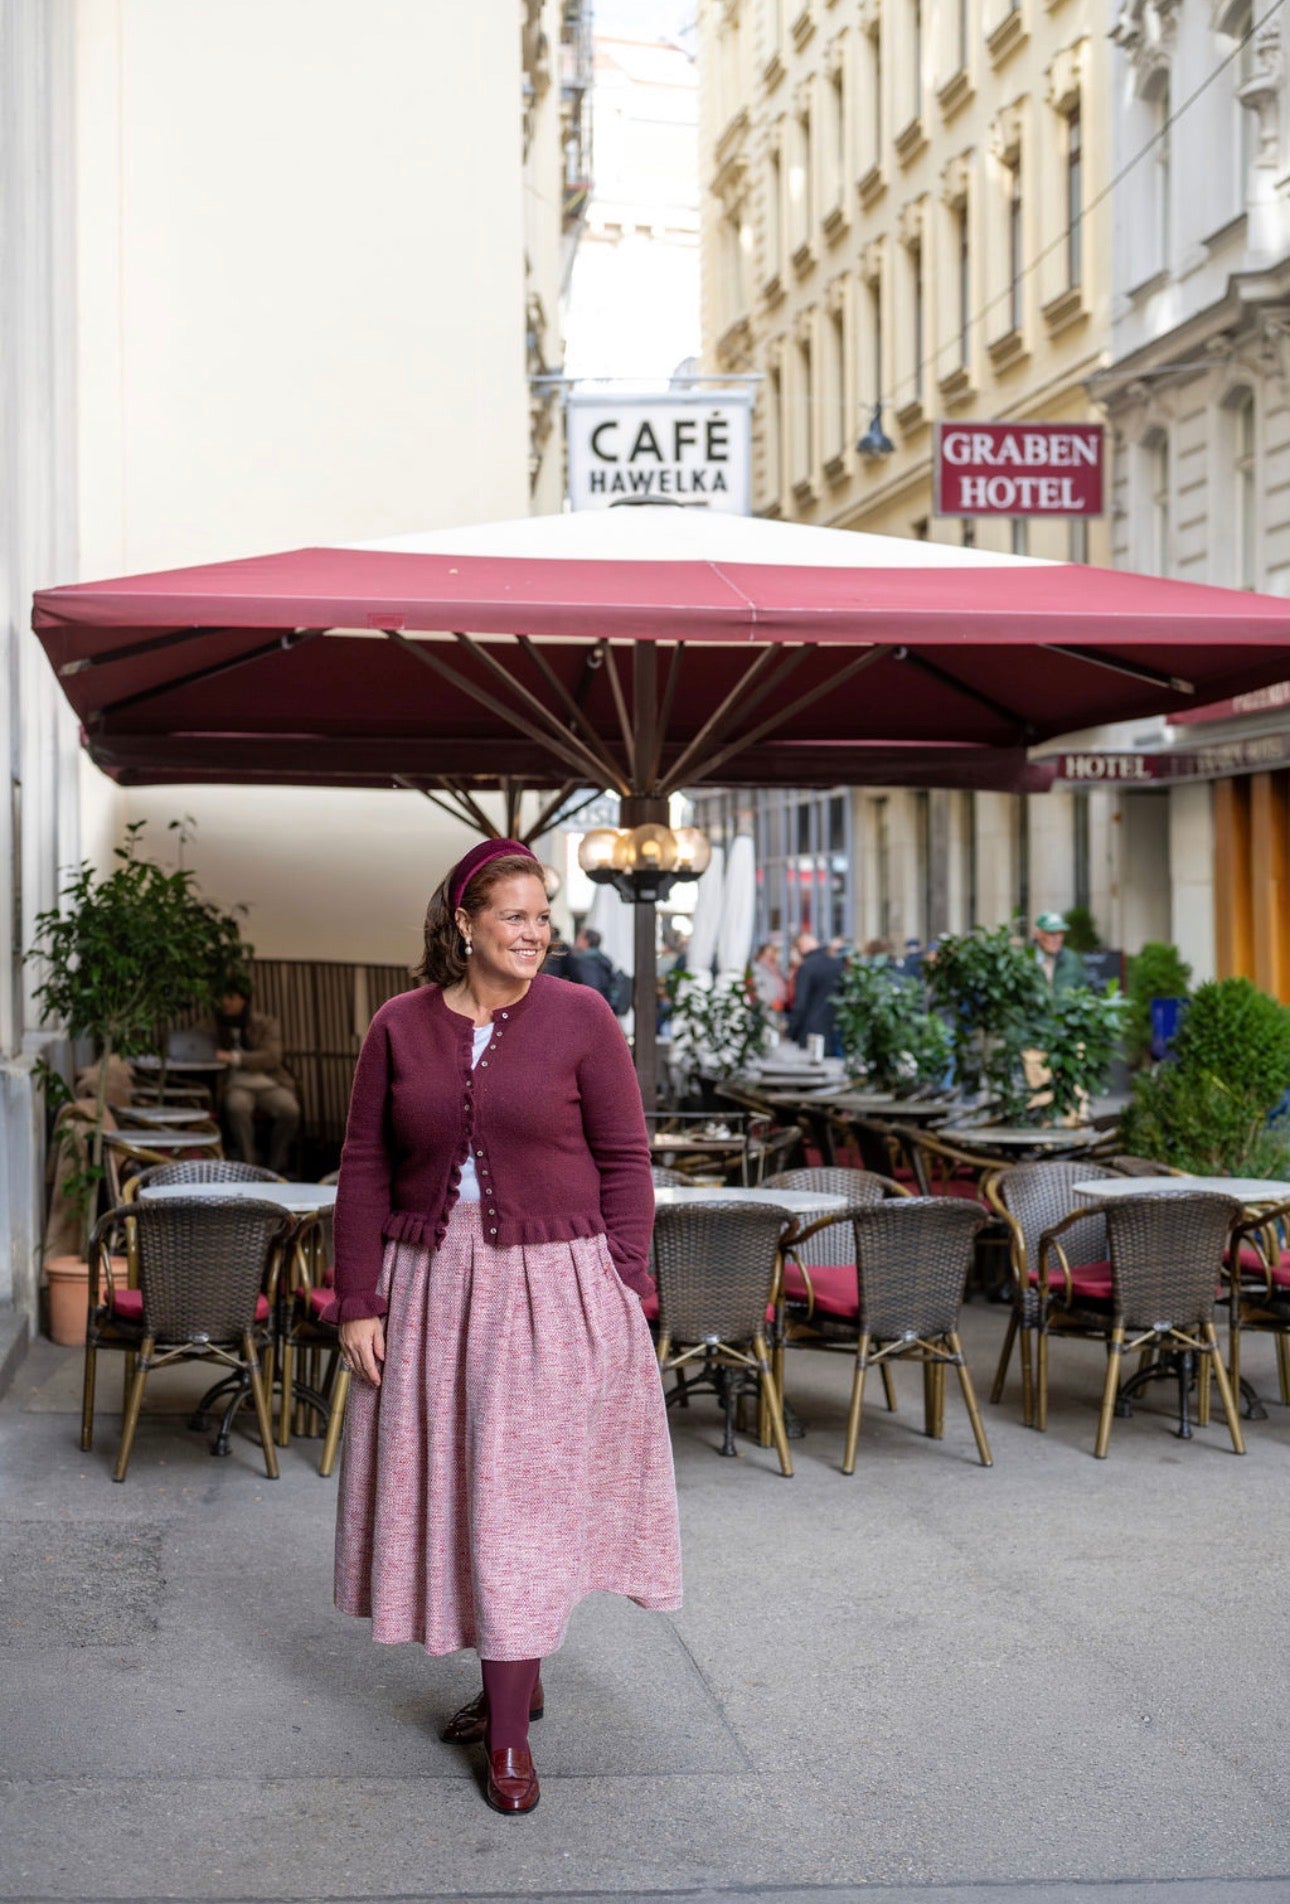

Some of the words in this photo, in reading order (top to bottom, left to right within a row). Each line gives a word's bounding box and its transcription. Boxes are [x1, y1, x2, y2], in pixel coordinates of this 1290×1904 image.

[590, 411, 728, 462] CAFÉ
[943, 432, 1098, 466] GRABEN
[590, 471, 727, 493] HAWELKA
[960, 475, 1085, 509] HOTEL
[1065, 756, 1150, 778] HOTEL
